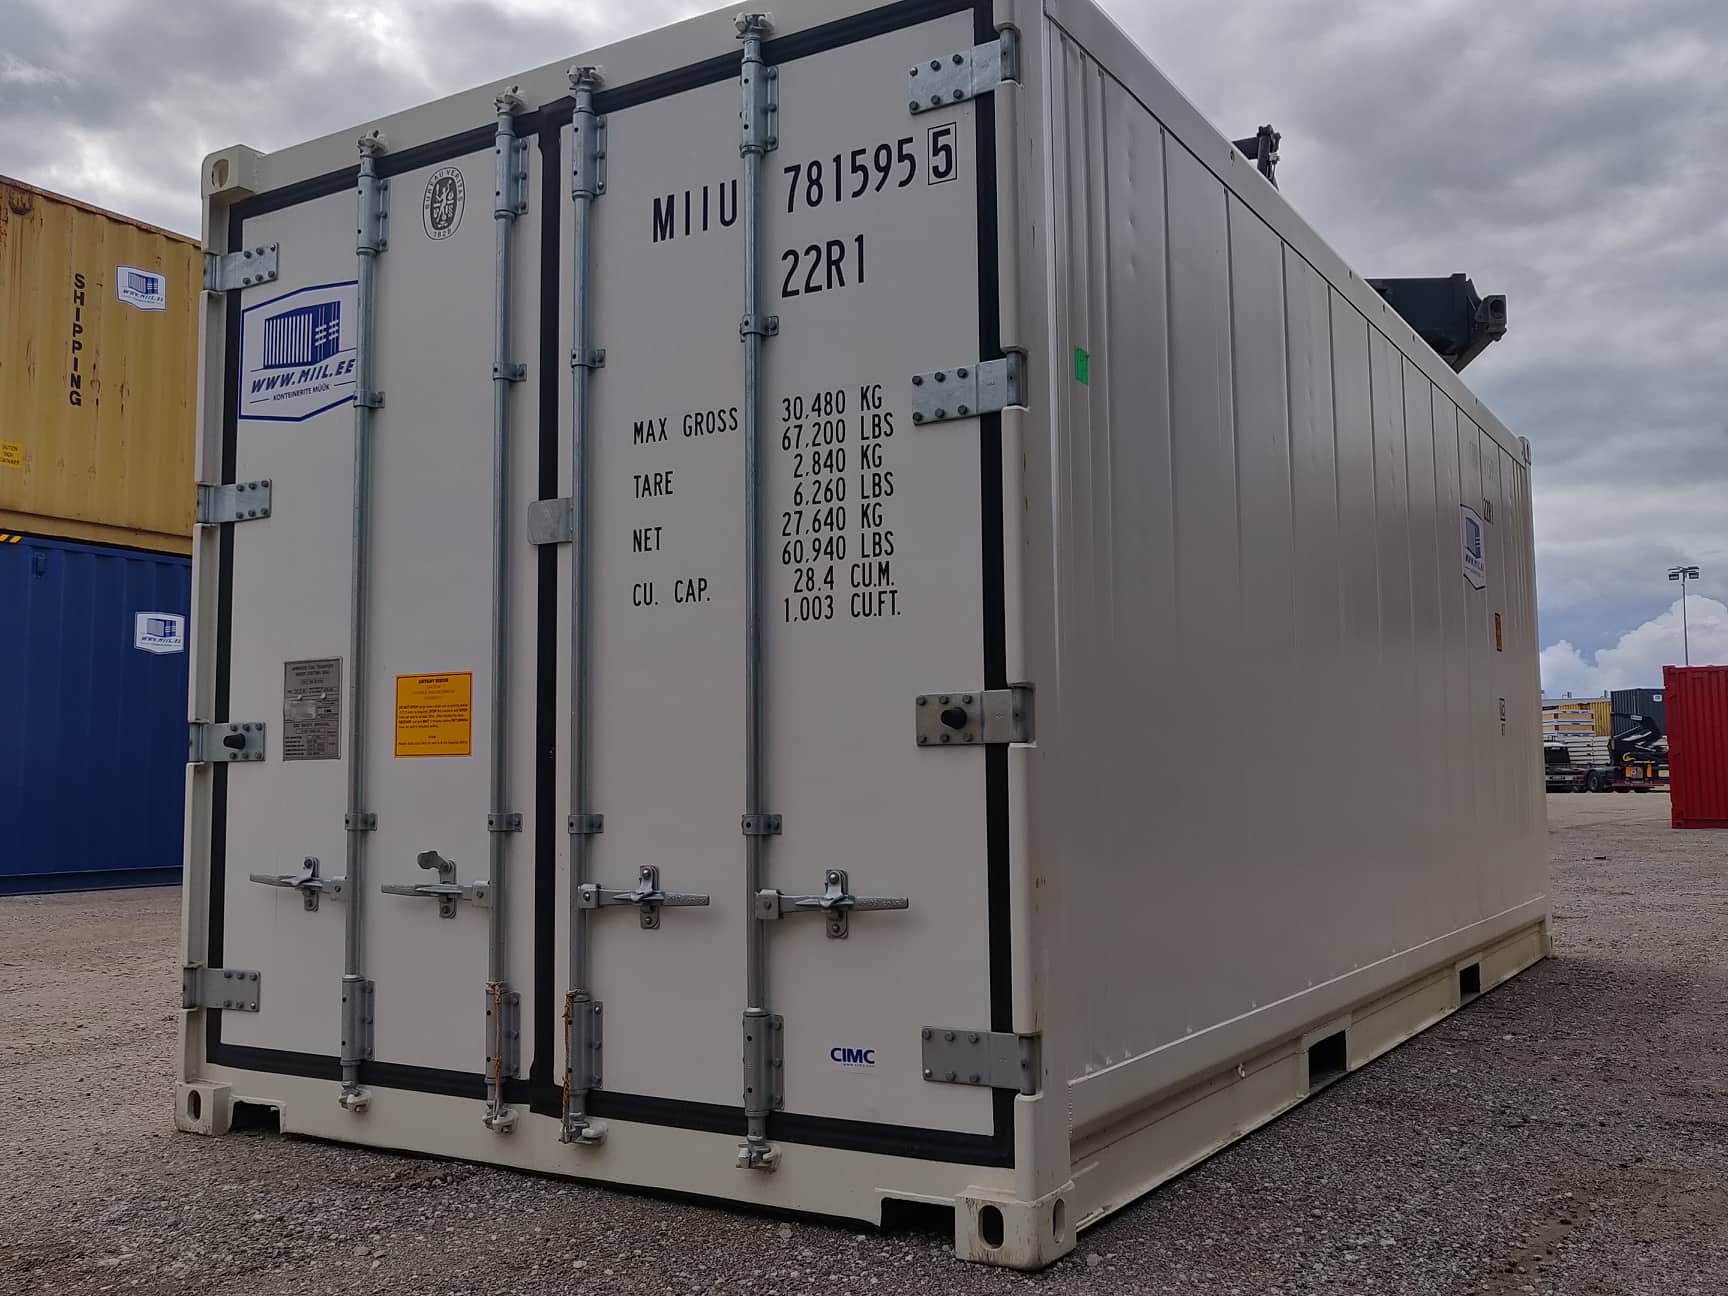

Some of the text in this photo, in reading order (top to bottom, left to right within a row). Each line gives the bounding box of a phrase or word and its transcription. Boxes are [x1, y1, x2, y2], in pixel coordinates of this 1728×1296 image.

[652, 125, 954, 244] MIIU 781595 5
[781, 233, 865, 299] 22R1
[69, 273, 87, 407] SHIPPING
[250, 358, 356, 394] WWW.MIIL.EE
[273, 388, 312, 401] KONTEINERITE
[633, 384, 883, 446] MAX GROSS 30,480 KG
[781, 411, 894, 451] 67,200 LBS
[633, 443, 883, 499] TARE 2,840 KG
[793, 471, 894, 507] 6,260 LBS
[632, 501, 883, 553] NET 27,640 KG
[781, 530, 895, 566] 60,940 LBS
[632, 560, 895, 607] CU. CAP. 28.4 CU.M.
[783, 589, 901, 623] 1,003 CU.FT.
[830, 1047, 875, 1064] CIMC
